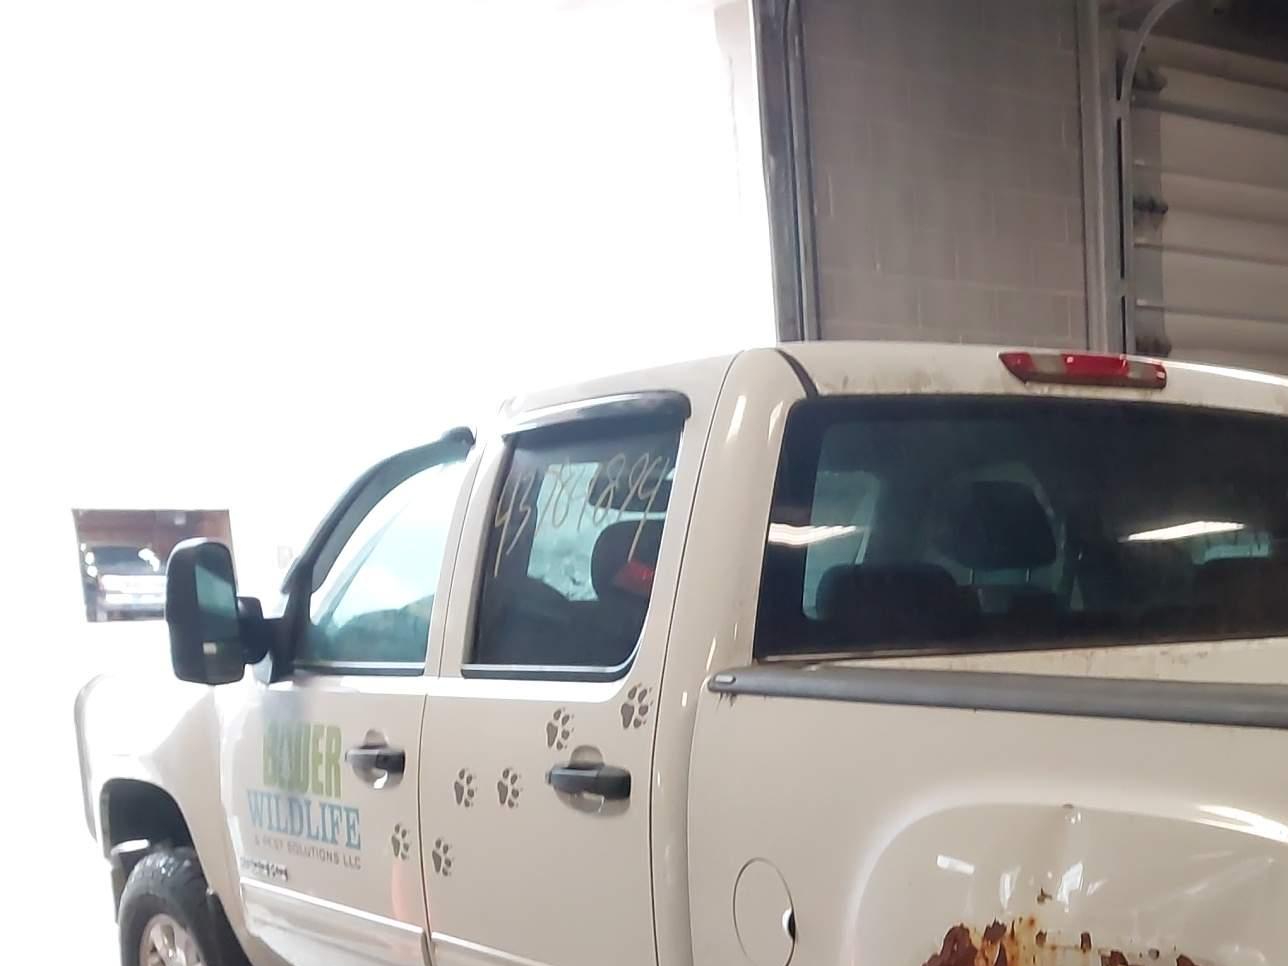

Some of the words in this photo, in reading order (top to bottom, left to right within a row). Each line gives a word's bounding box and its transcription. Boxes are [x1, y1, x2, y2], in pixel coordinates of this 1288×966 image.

[247, 788, 362, 850] WILDLIFE
[287, 840, 340, 865] SOLUTIONS
[342, 851, 362, 870] LLC
